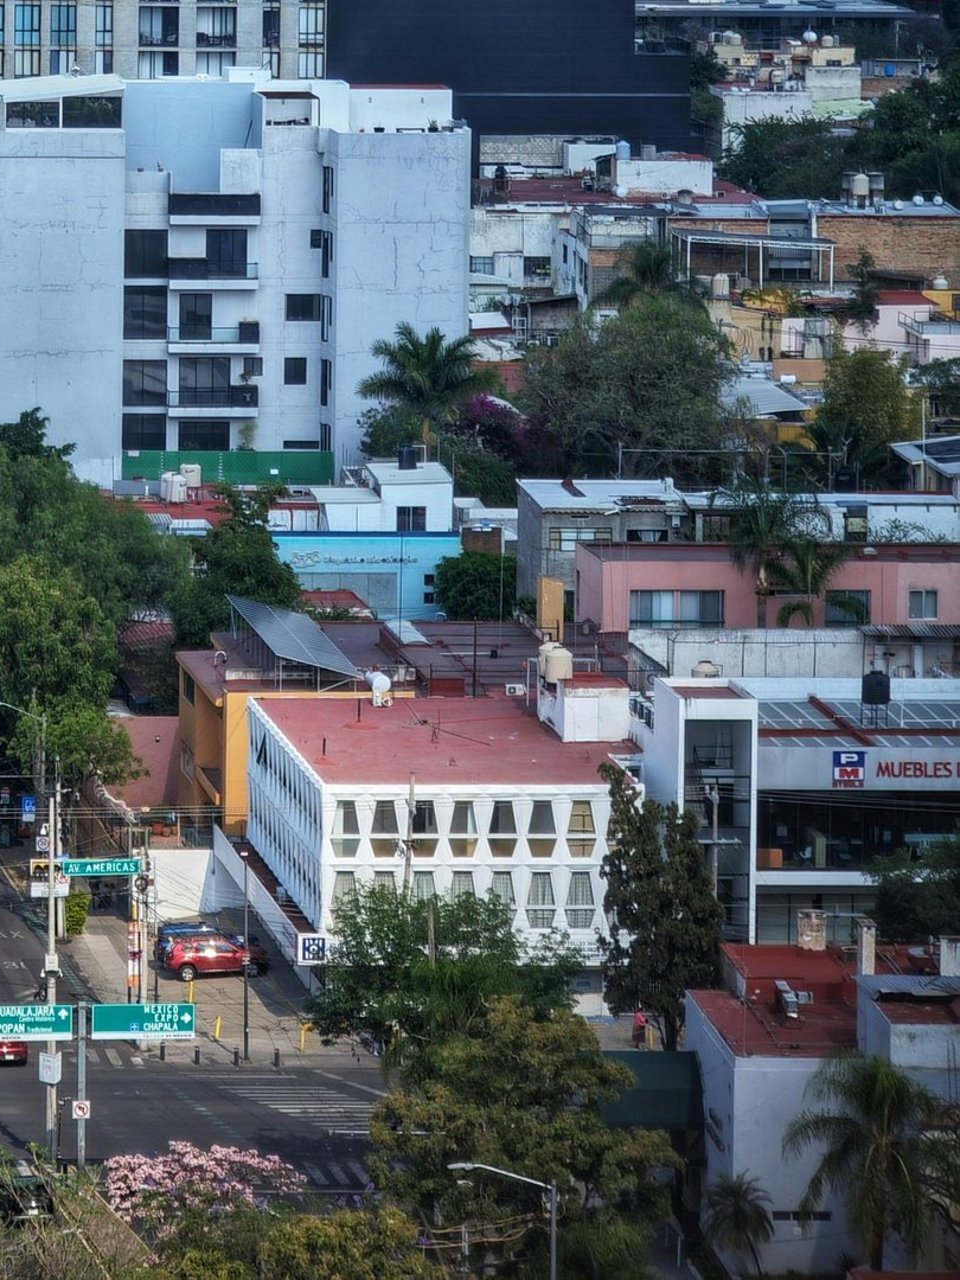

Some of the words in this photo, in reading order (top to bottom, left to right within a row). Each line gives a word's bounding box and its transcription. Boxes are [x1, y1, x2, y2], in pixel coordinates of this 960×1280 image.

[876, 762, 953, 778] MUEBLES
[68, 864, 81, 873] AV.
[85, 862, 136, 872] AMERICAS
[154, 1014, 179, 1022] EXPO
[143, 1023, 179, 1031] CHAPALA
